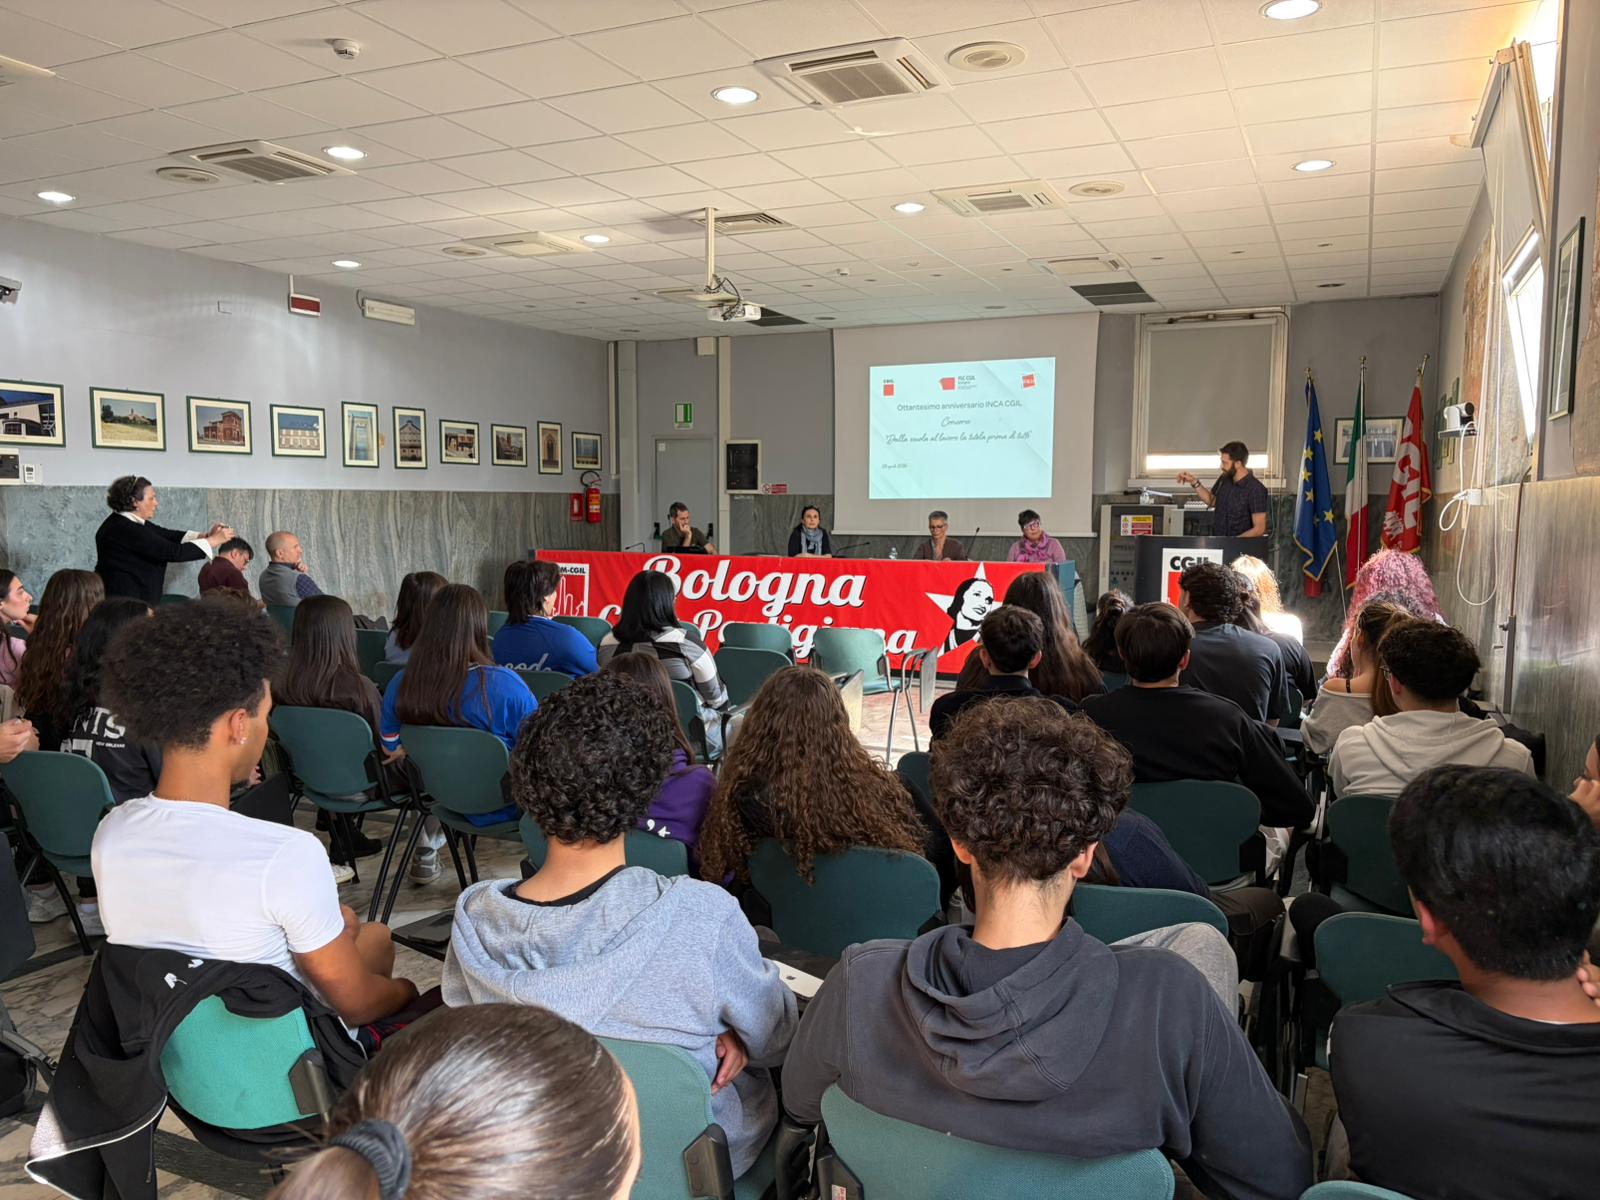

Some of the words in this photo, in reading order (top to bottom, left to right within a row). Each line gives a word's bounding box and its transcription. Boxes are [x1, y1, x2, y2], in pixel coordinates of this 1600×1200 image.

[897, 402, 940, 412] Ottantesimo
[941, 400, 984, 410] anniversario
[985, 400, 1004, 408] INCA
[960, 432, 967, 441] la
[560, 566, 586, 574] M-CGIL
